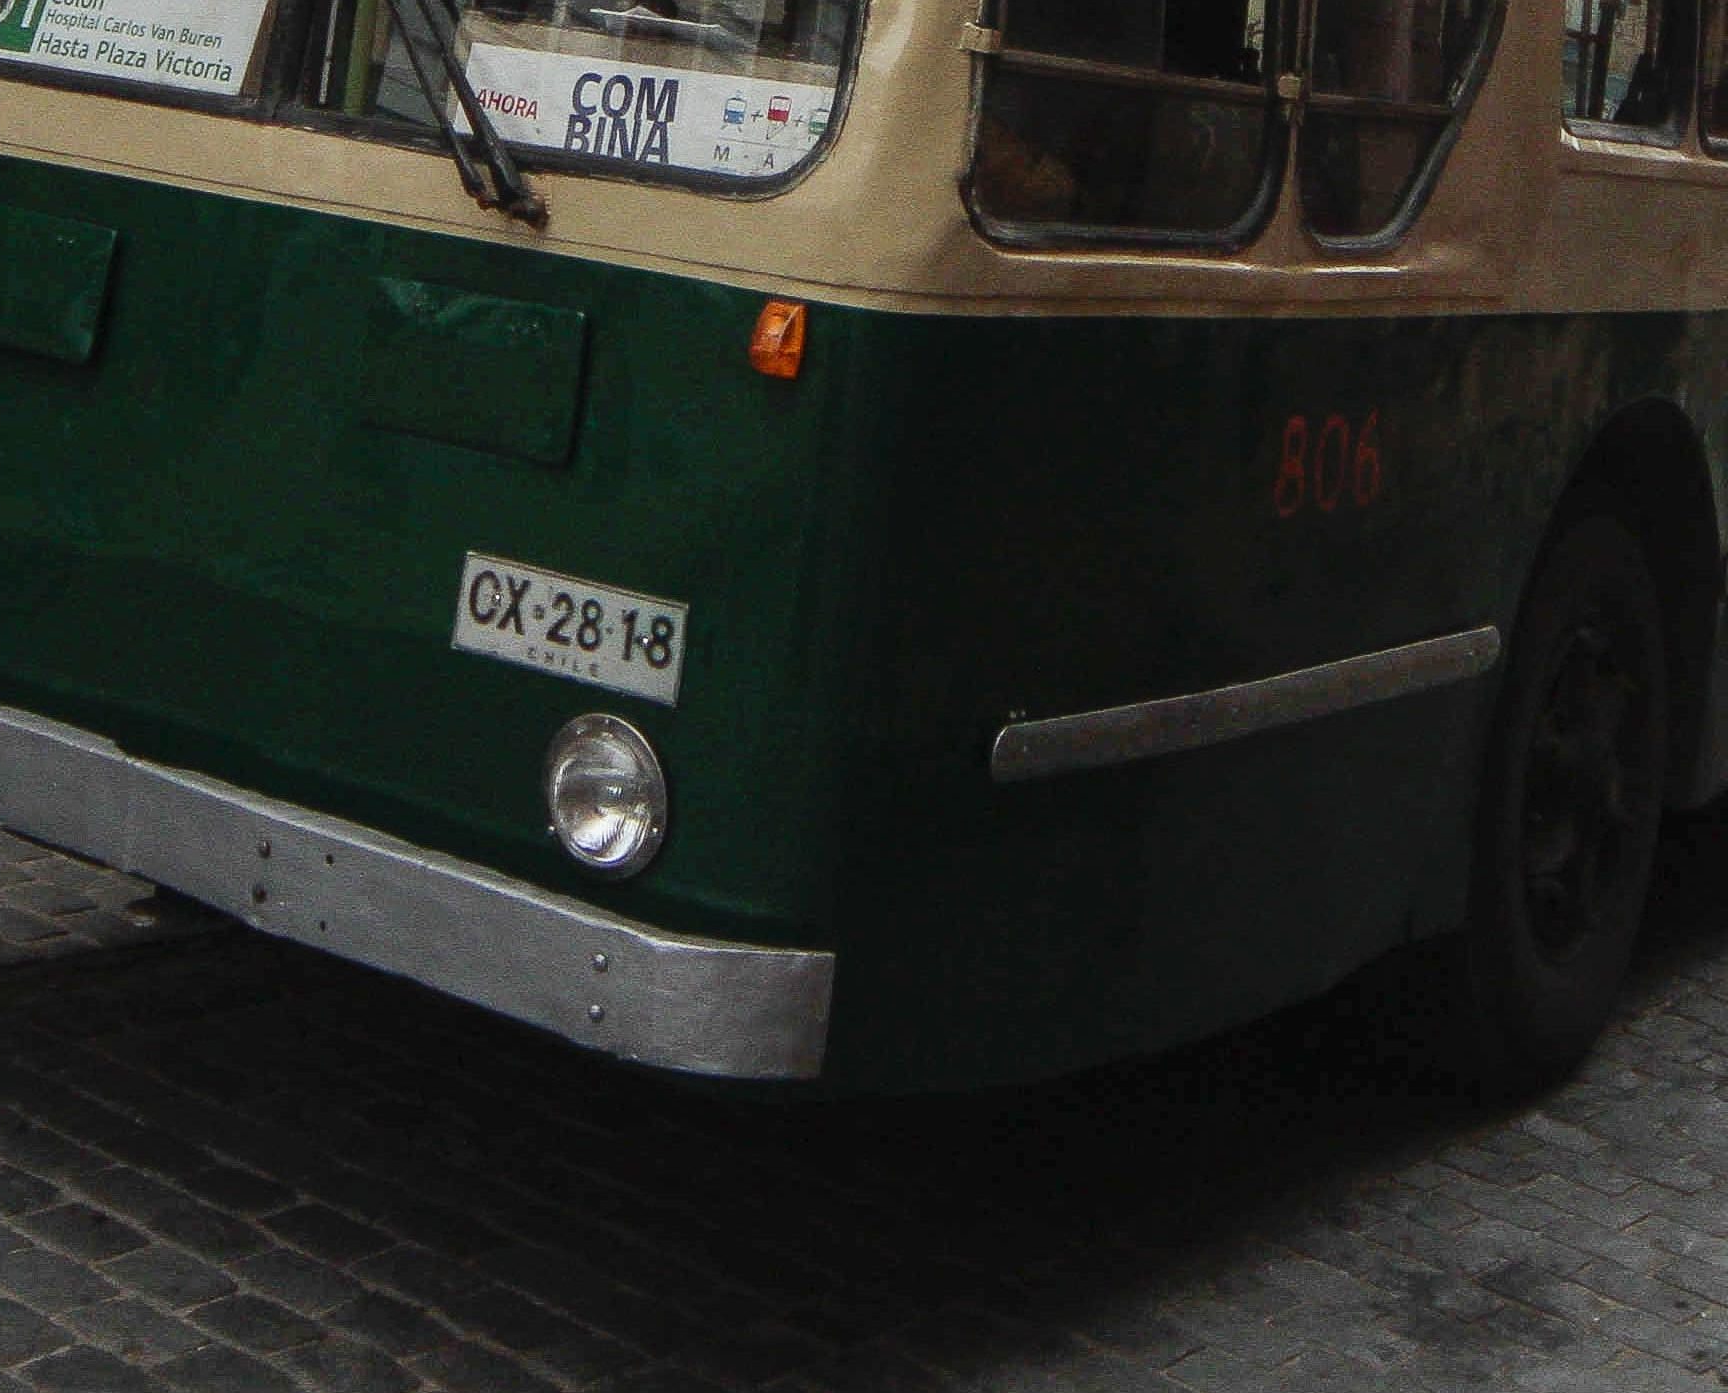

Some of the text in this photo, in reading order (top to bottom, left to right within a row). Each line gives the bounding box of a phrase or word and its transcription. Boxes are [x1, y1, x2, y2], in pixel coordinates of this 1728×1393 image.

[45, 10, 222, 49] Hospital Carlos Van Buren
[37, 32, 232, 82] Hasta Plaza Victoria
[477, 89, 538, 120] AHORA
[573, 72, 680, 123] COM
[565, 113, 670, 165] BINA
[1273, 408, 1382, 518] 806
